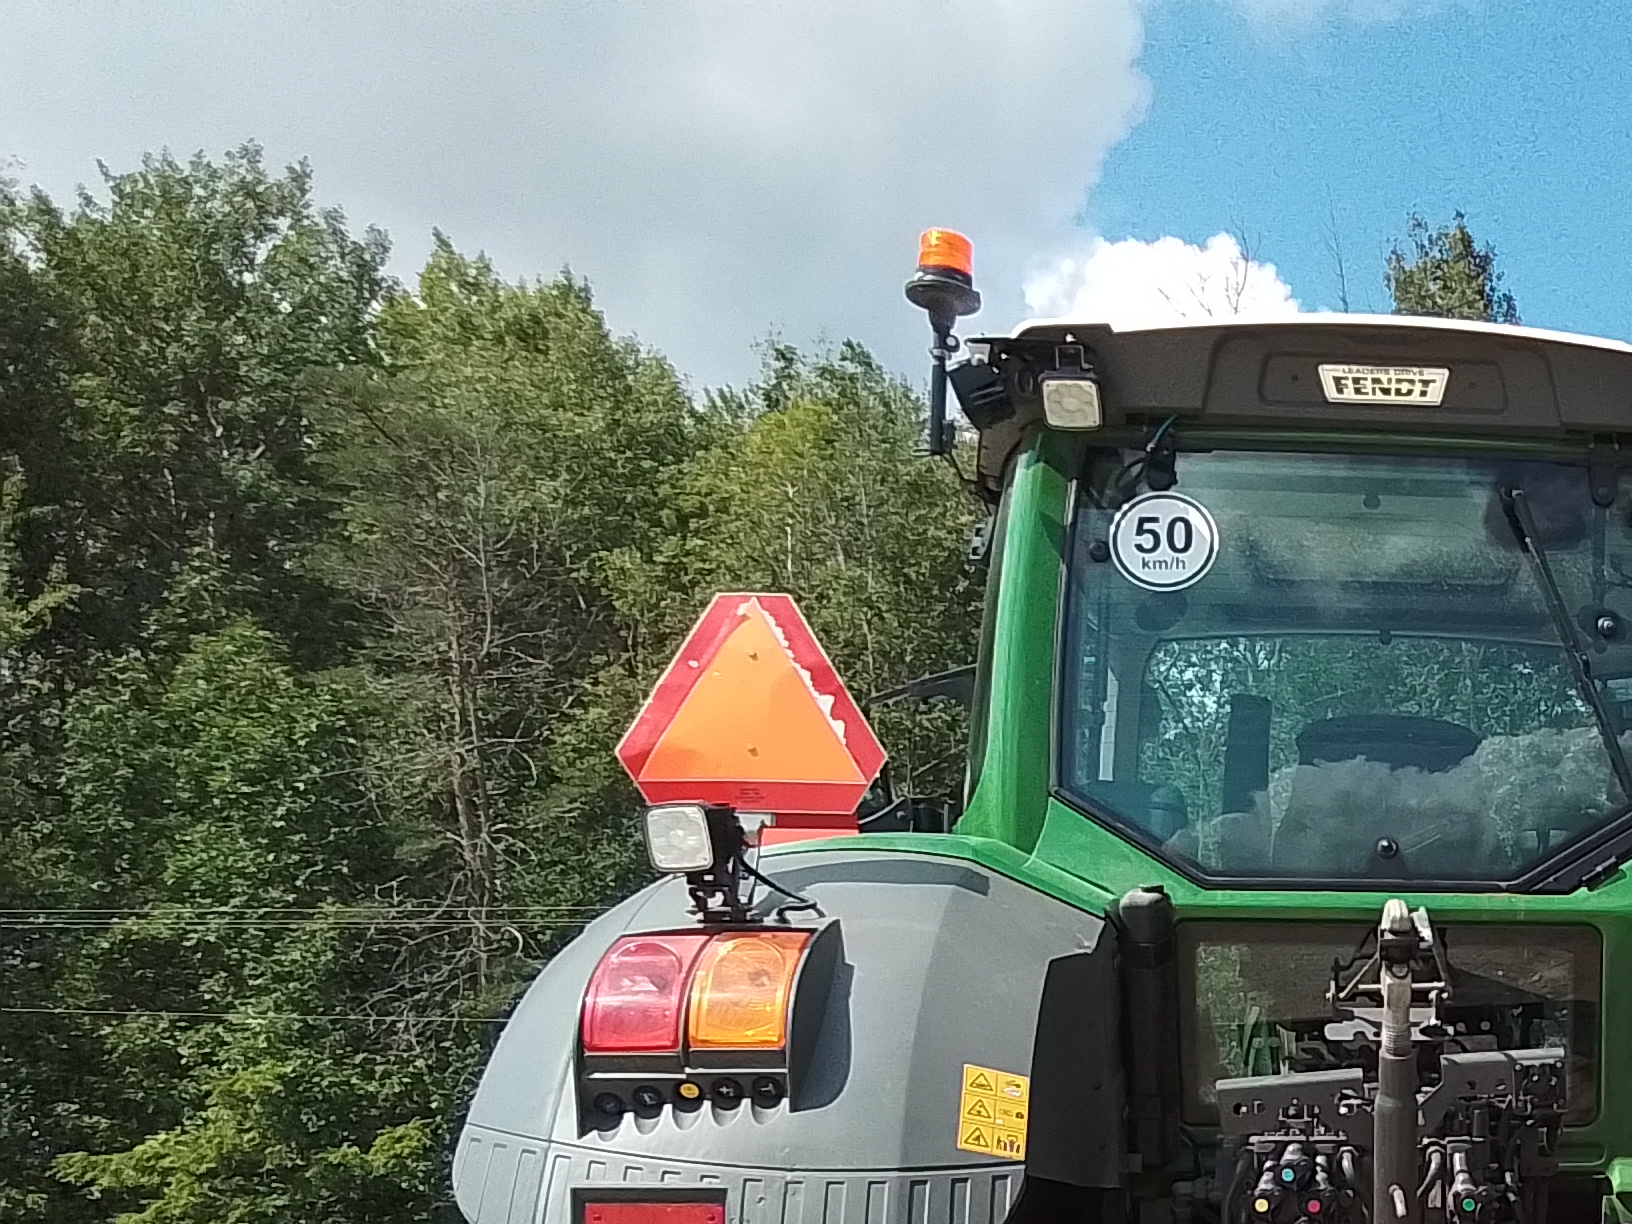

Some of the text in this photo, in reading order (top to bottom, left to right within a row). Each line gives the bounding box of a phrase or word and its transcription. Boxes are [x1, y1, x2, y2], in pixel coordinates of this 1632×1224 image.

[1331, 375, 1437, 398] FENDT
[1133, 516, 1193, 554] 50
[1141, 556, 1187, 571] km/h
